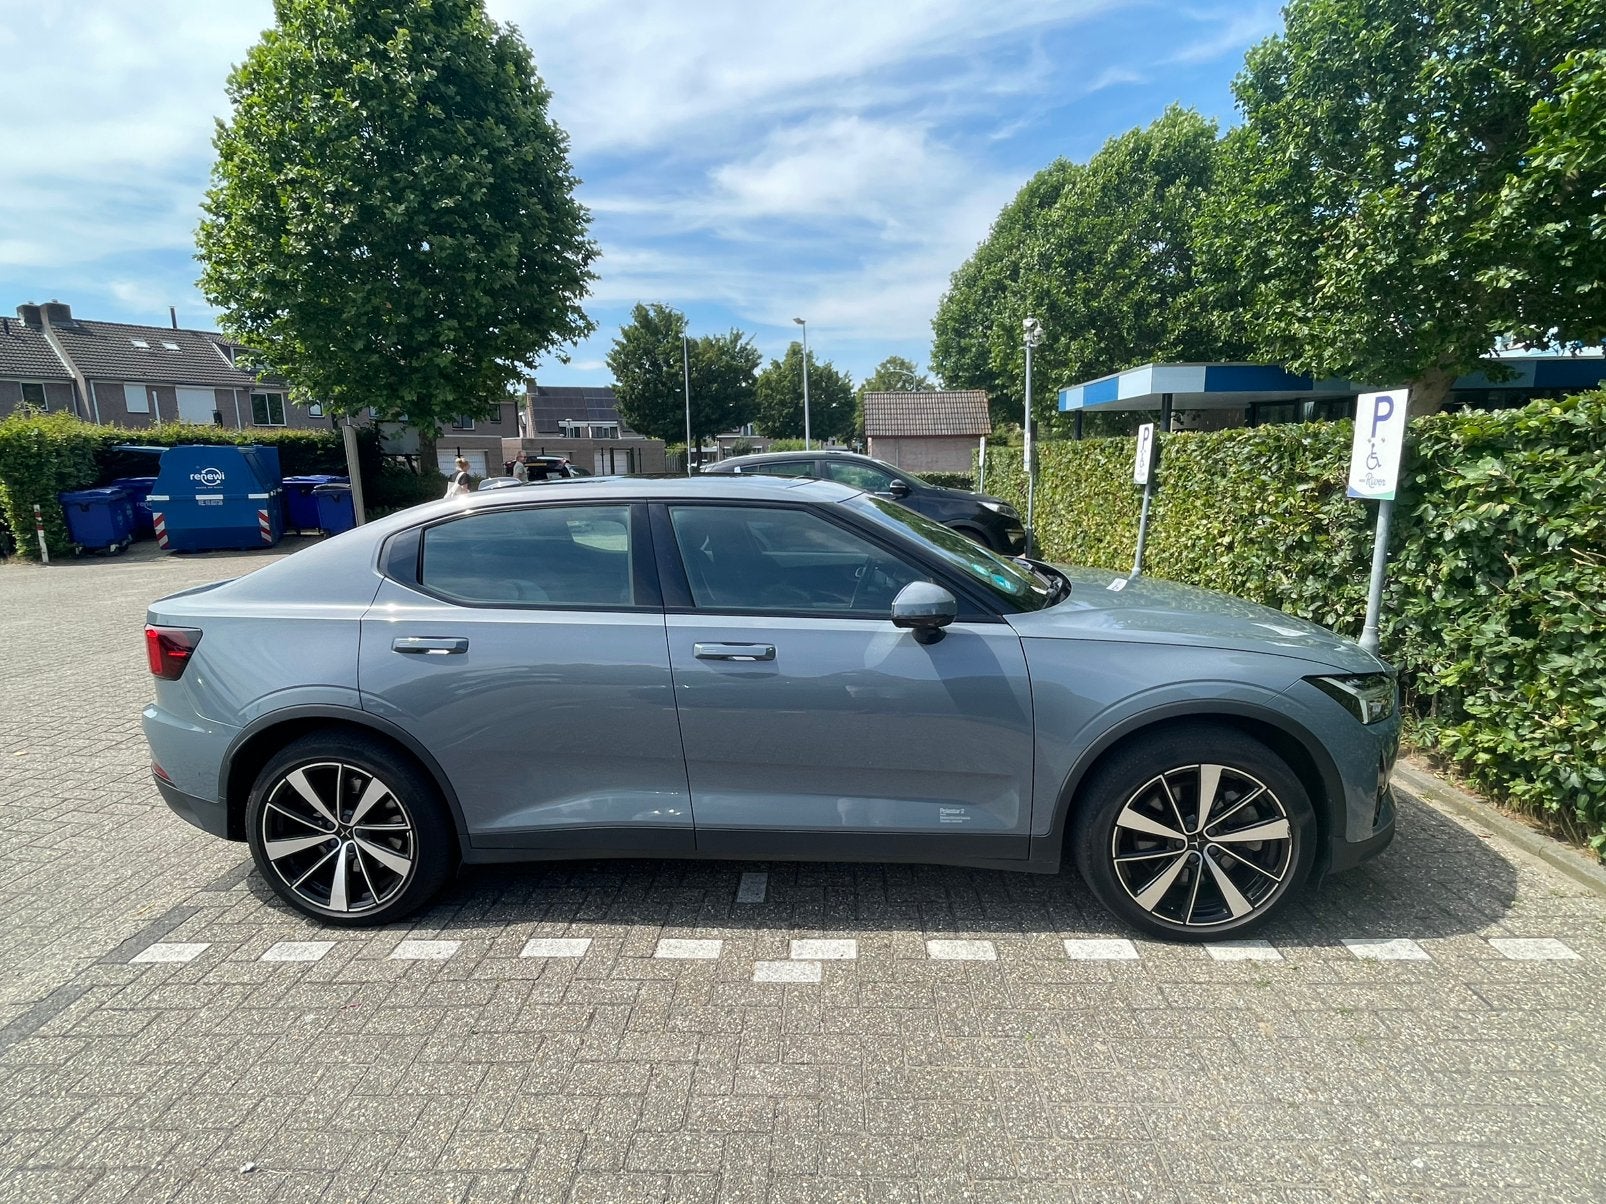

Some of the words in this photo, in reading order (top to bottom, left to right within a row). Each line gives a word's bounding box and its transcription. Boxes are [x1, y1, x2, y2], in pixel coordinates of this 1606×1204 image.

[1371, 395, 1394, 438] P
[1142, 426, 1150, 451] P
[190, 470, 225, 482] renewi
